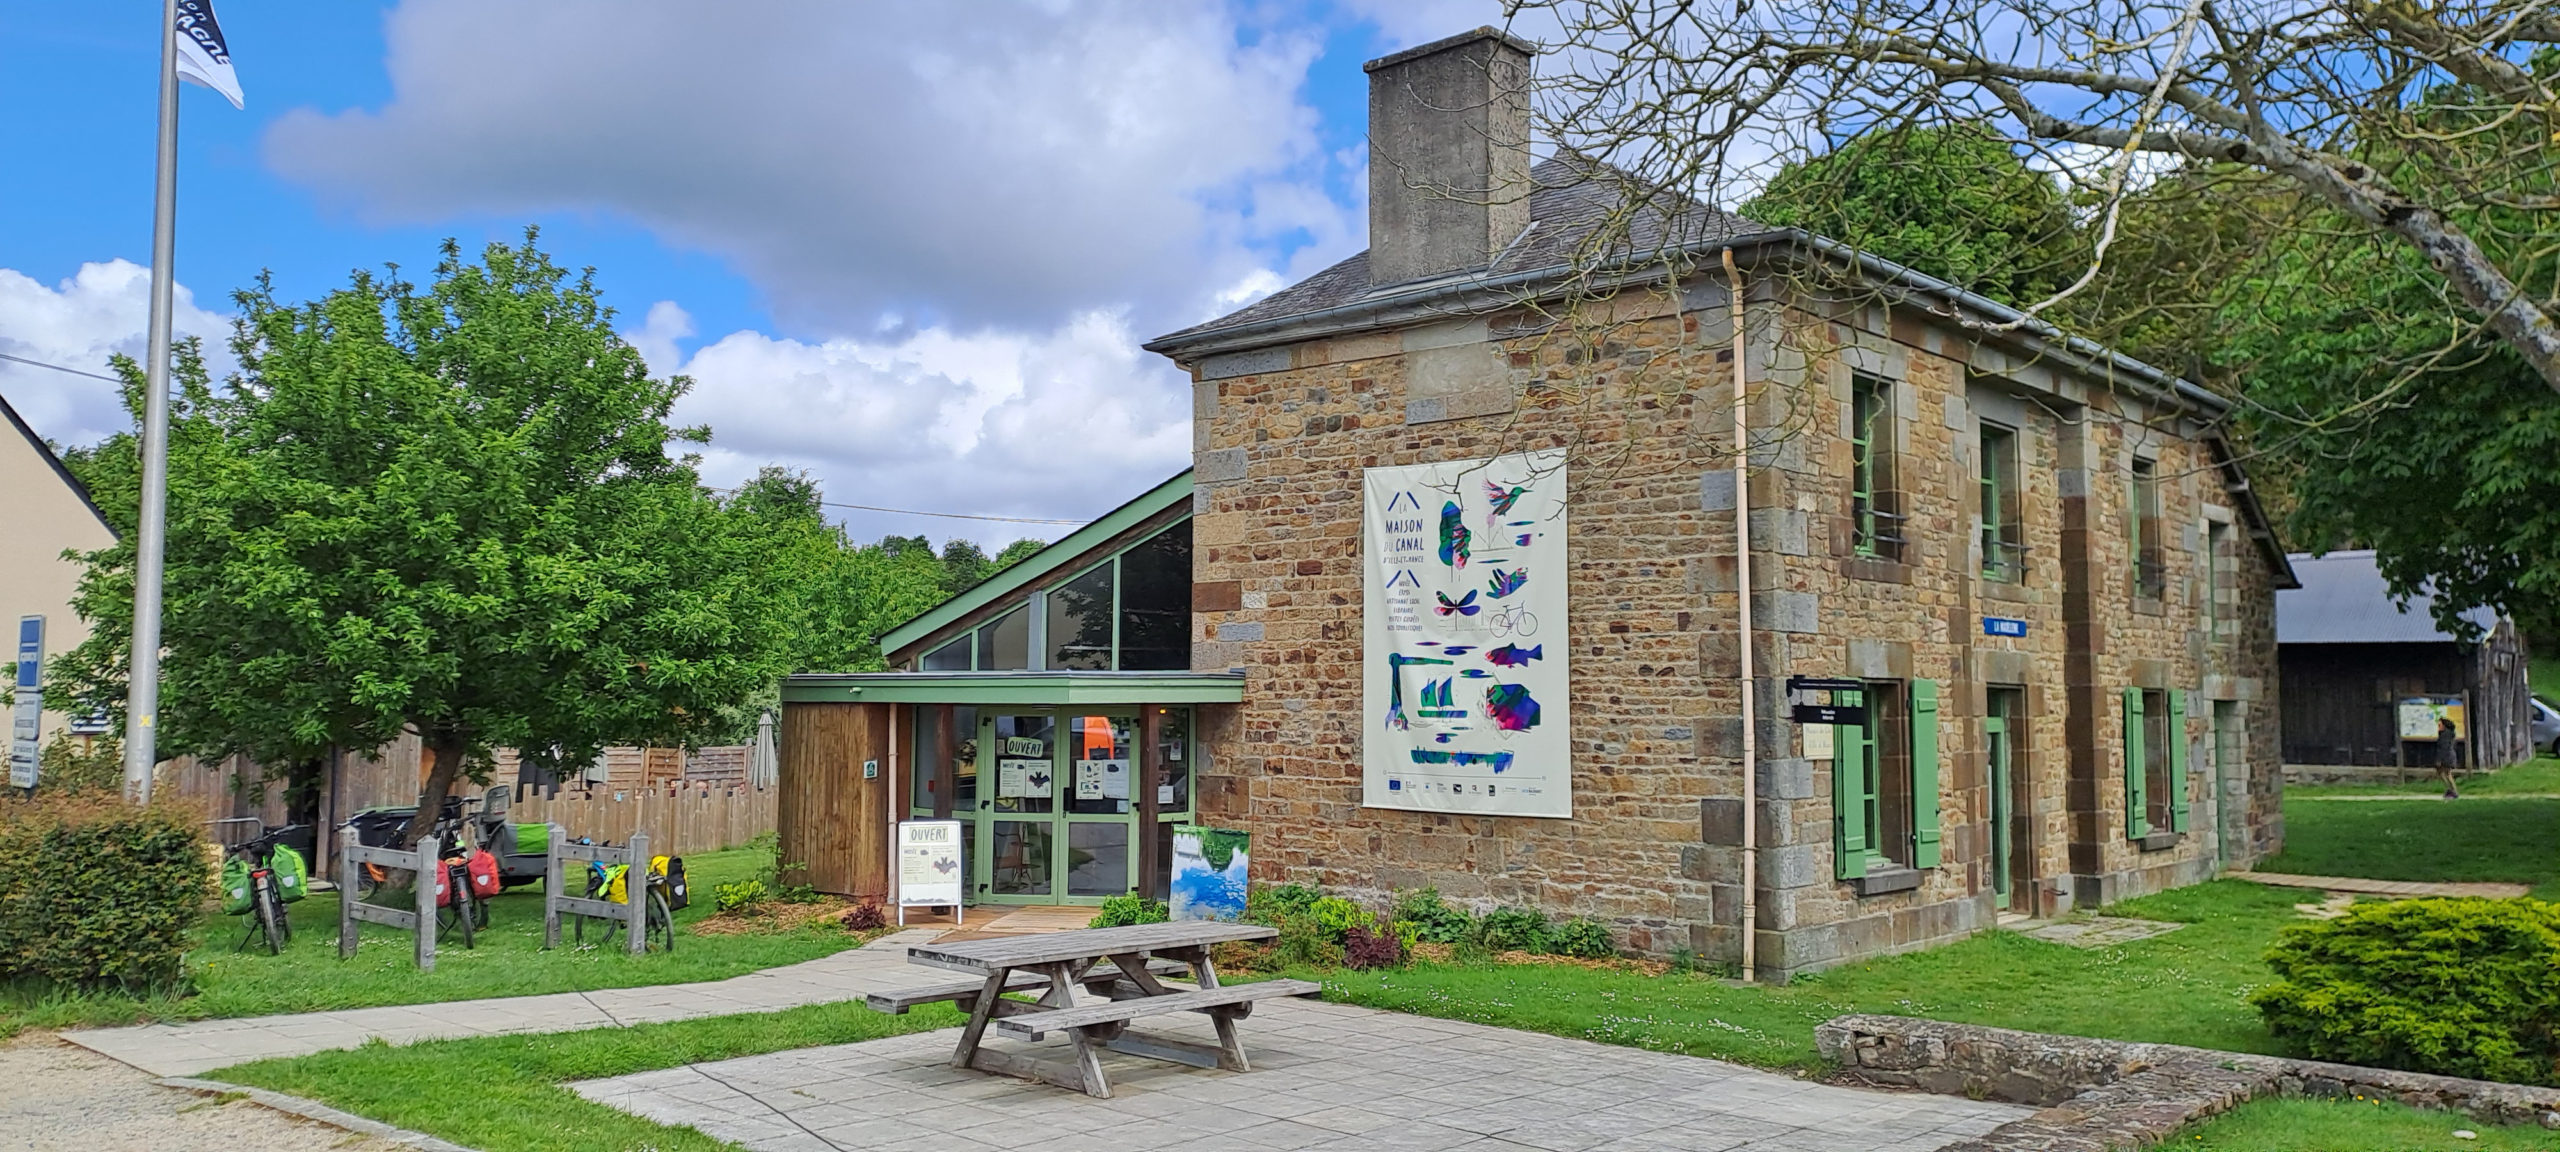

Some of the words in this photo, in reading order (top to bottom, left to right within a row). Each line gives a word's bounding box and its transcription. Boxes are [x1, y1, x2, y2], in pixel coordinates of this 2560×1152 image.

[1399, 503, 1407, 514] LA
[1385, 518, 1423, 534] MAISON
[1384, 541, 1393, 552] DU
[1396, 537, 1424, 552] CANAL
[1009, 740, 1042, 755] OUVERT
[911, 829, 947, 841] OUVERT
